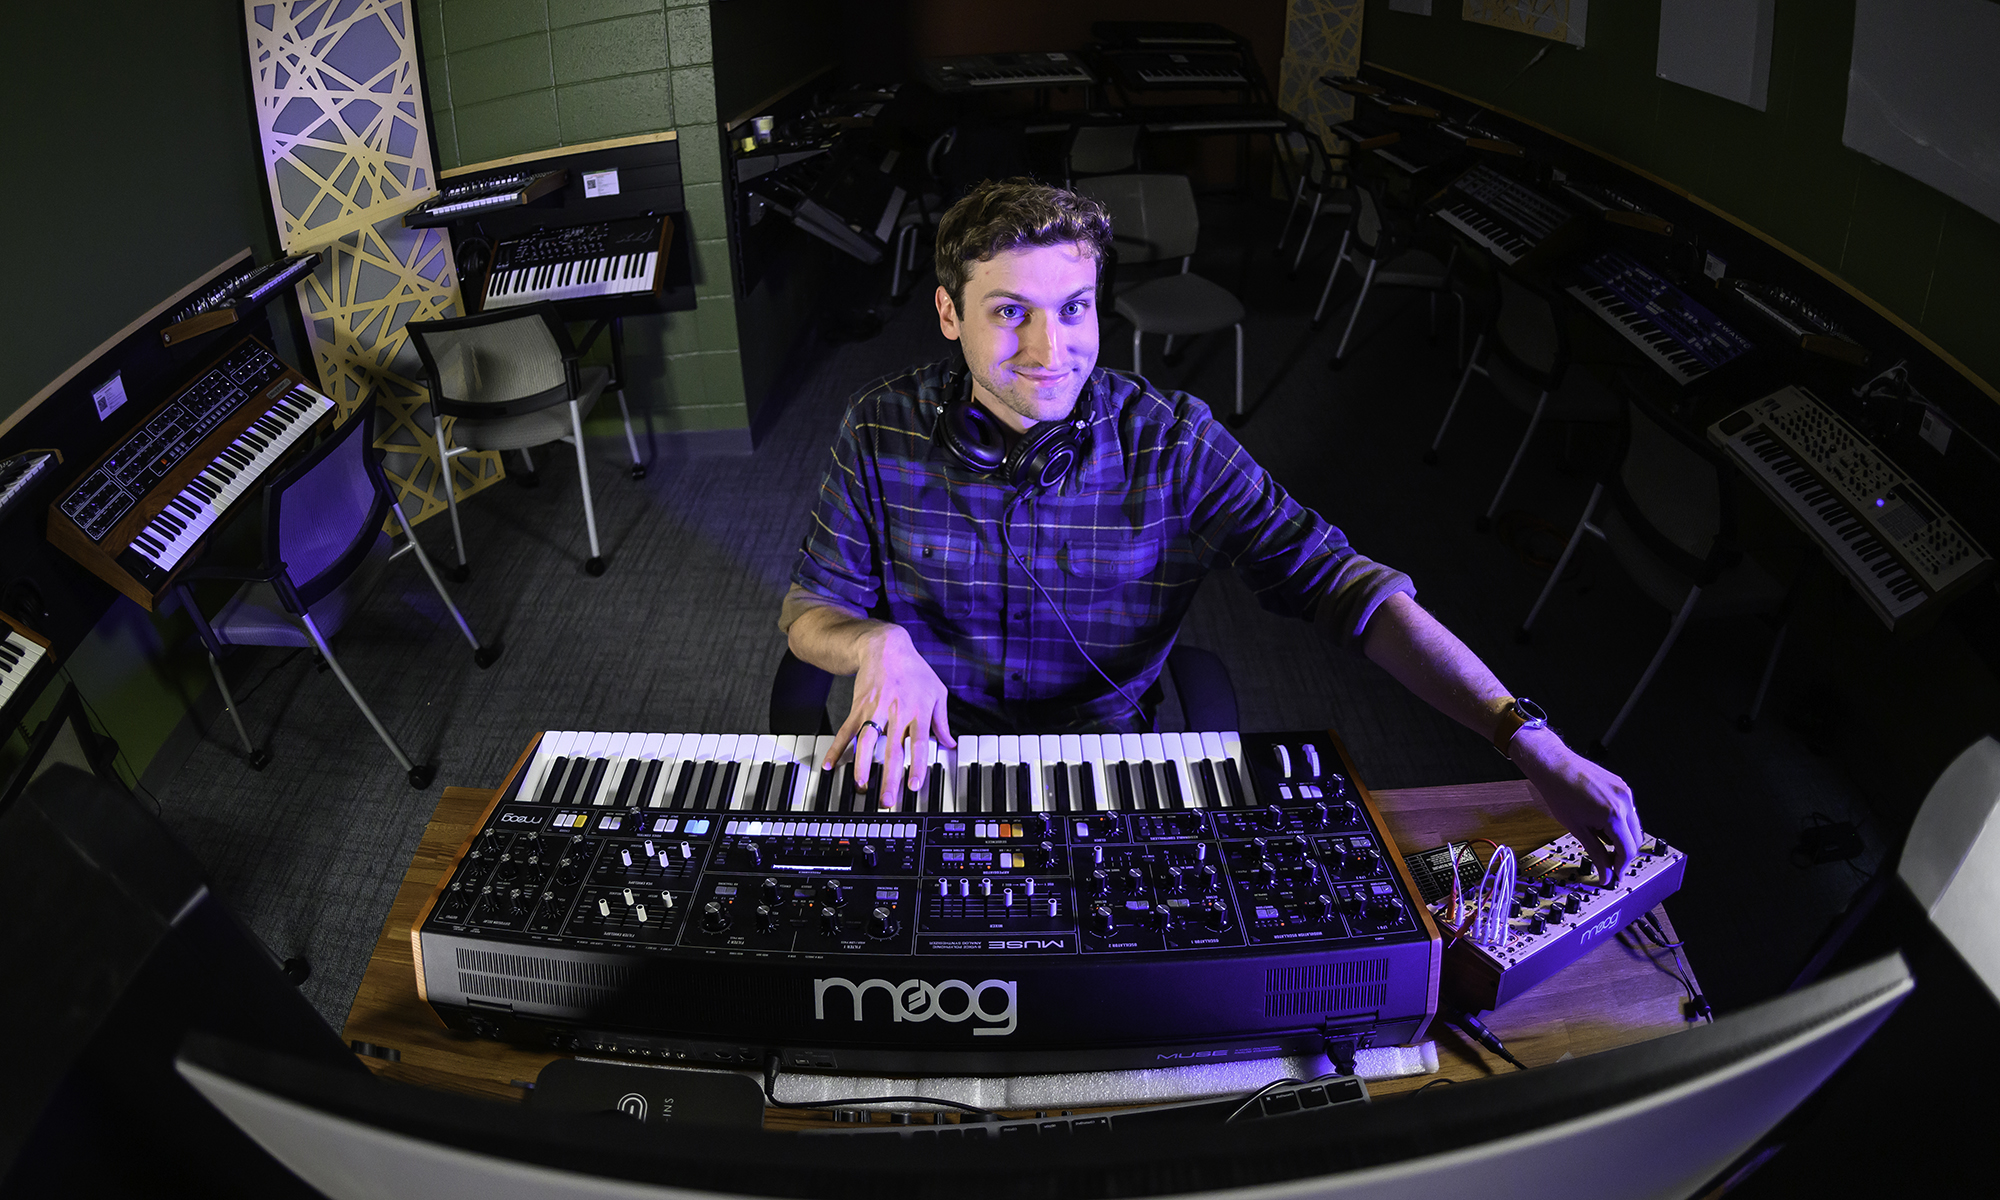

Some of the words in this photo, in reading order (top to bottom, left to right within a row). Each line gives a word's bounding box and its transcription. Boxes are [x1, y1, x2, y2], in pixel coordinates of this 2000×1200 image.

[501, 812, 543, 824] moog
[1579, 907, 1622, 945] moog
[988, 939, 1064, 949] MUSE
[814, 977, 1018, 1036] moog
[1156, 1049, 1229, 1060] MUSE
